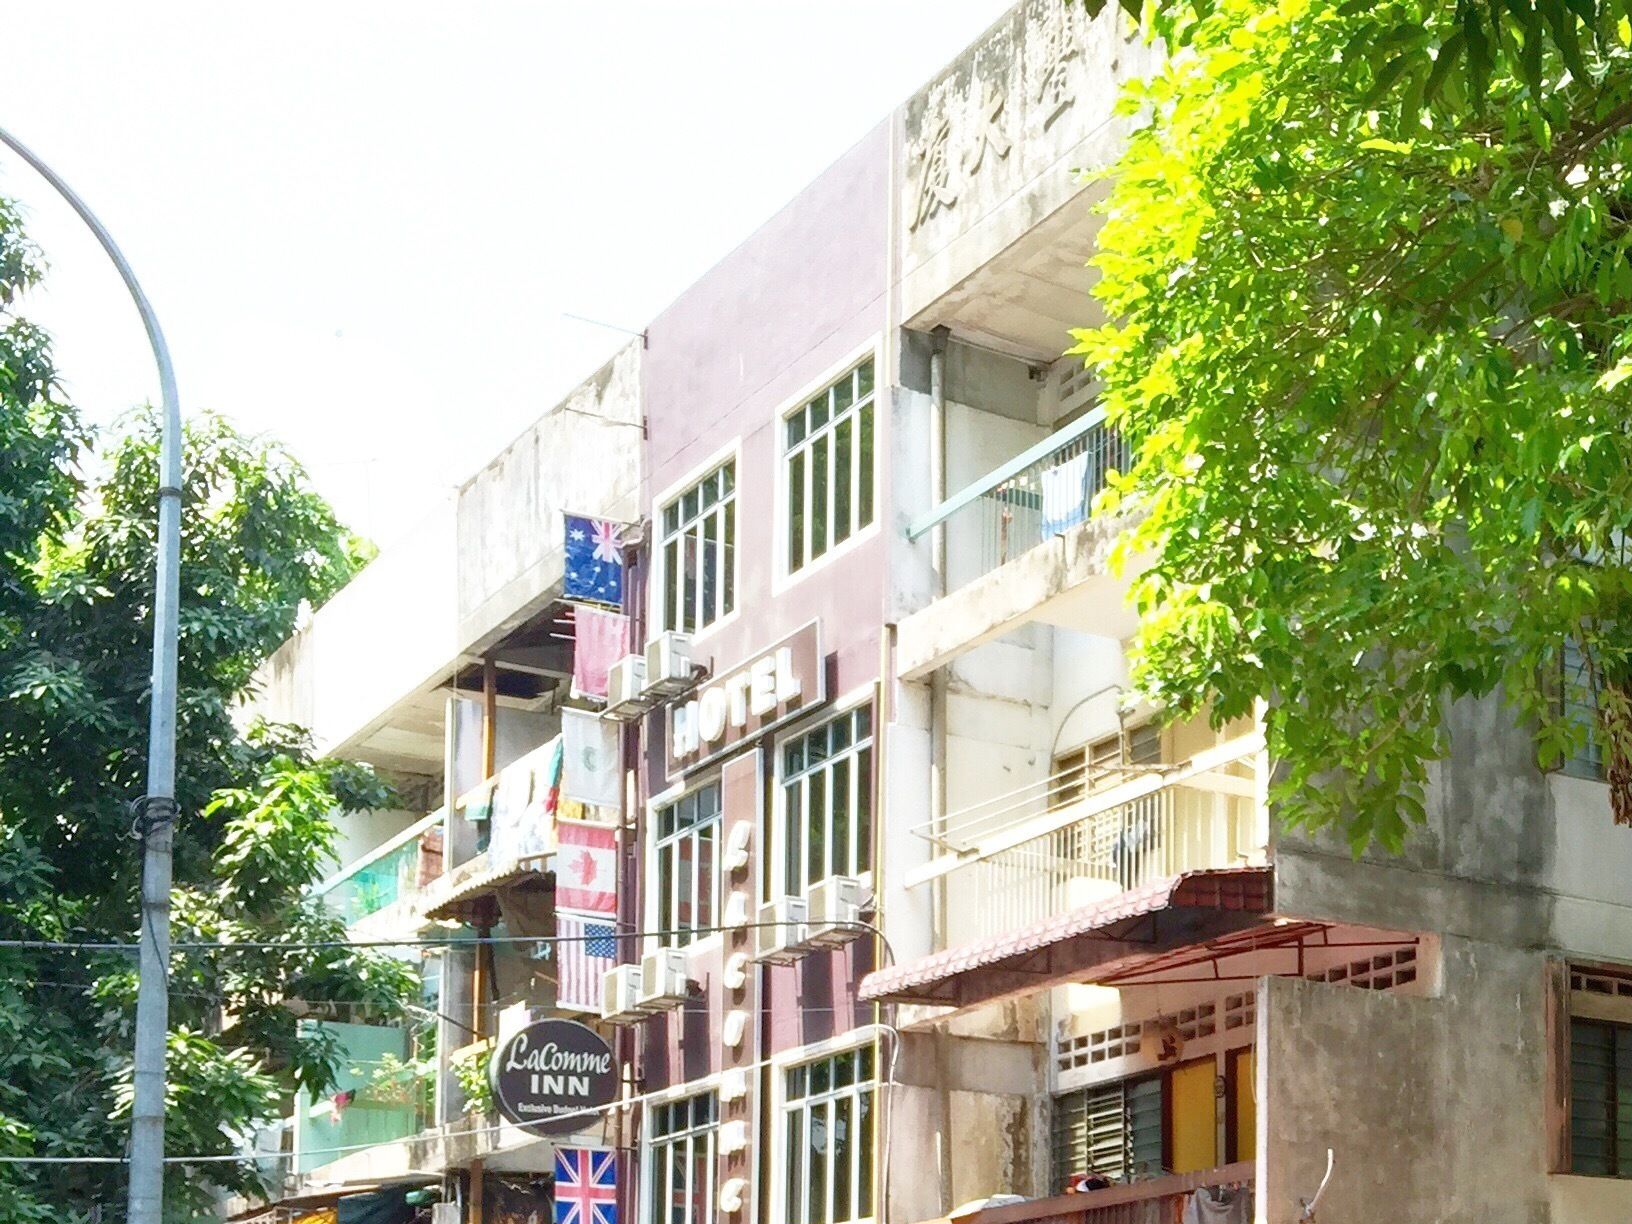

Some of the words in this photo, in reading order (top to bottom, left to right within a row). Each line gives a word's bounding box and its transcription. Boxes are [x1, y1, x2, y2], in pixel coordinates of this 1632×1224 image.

[673, 646, 801, 758] HOTEL
[506, 1033, 611, 1075] LaComme
[530, 1074, 590, 1097] INN
